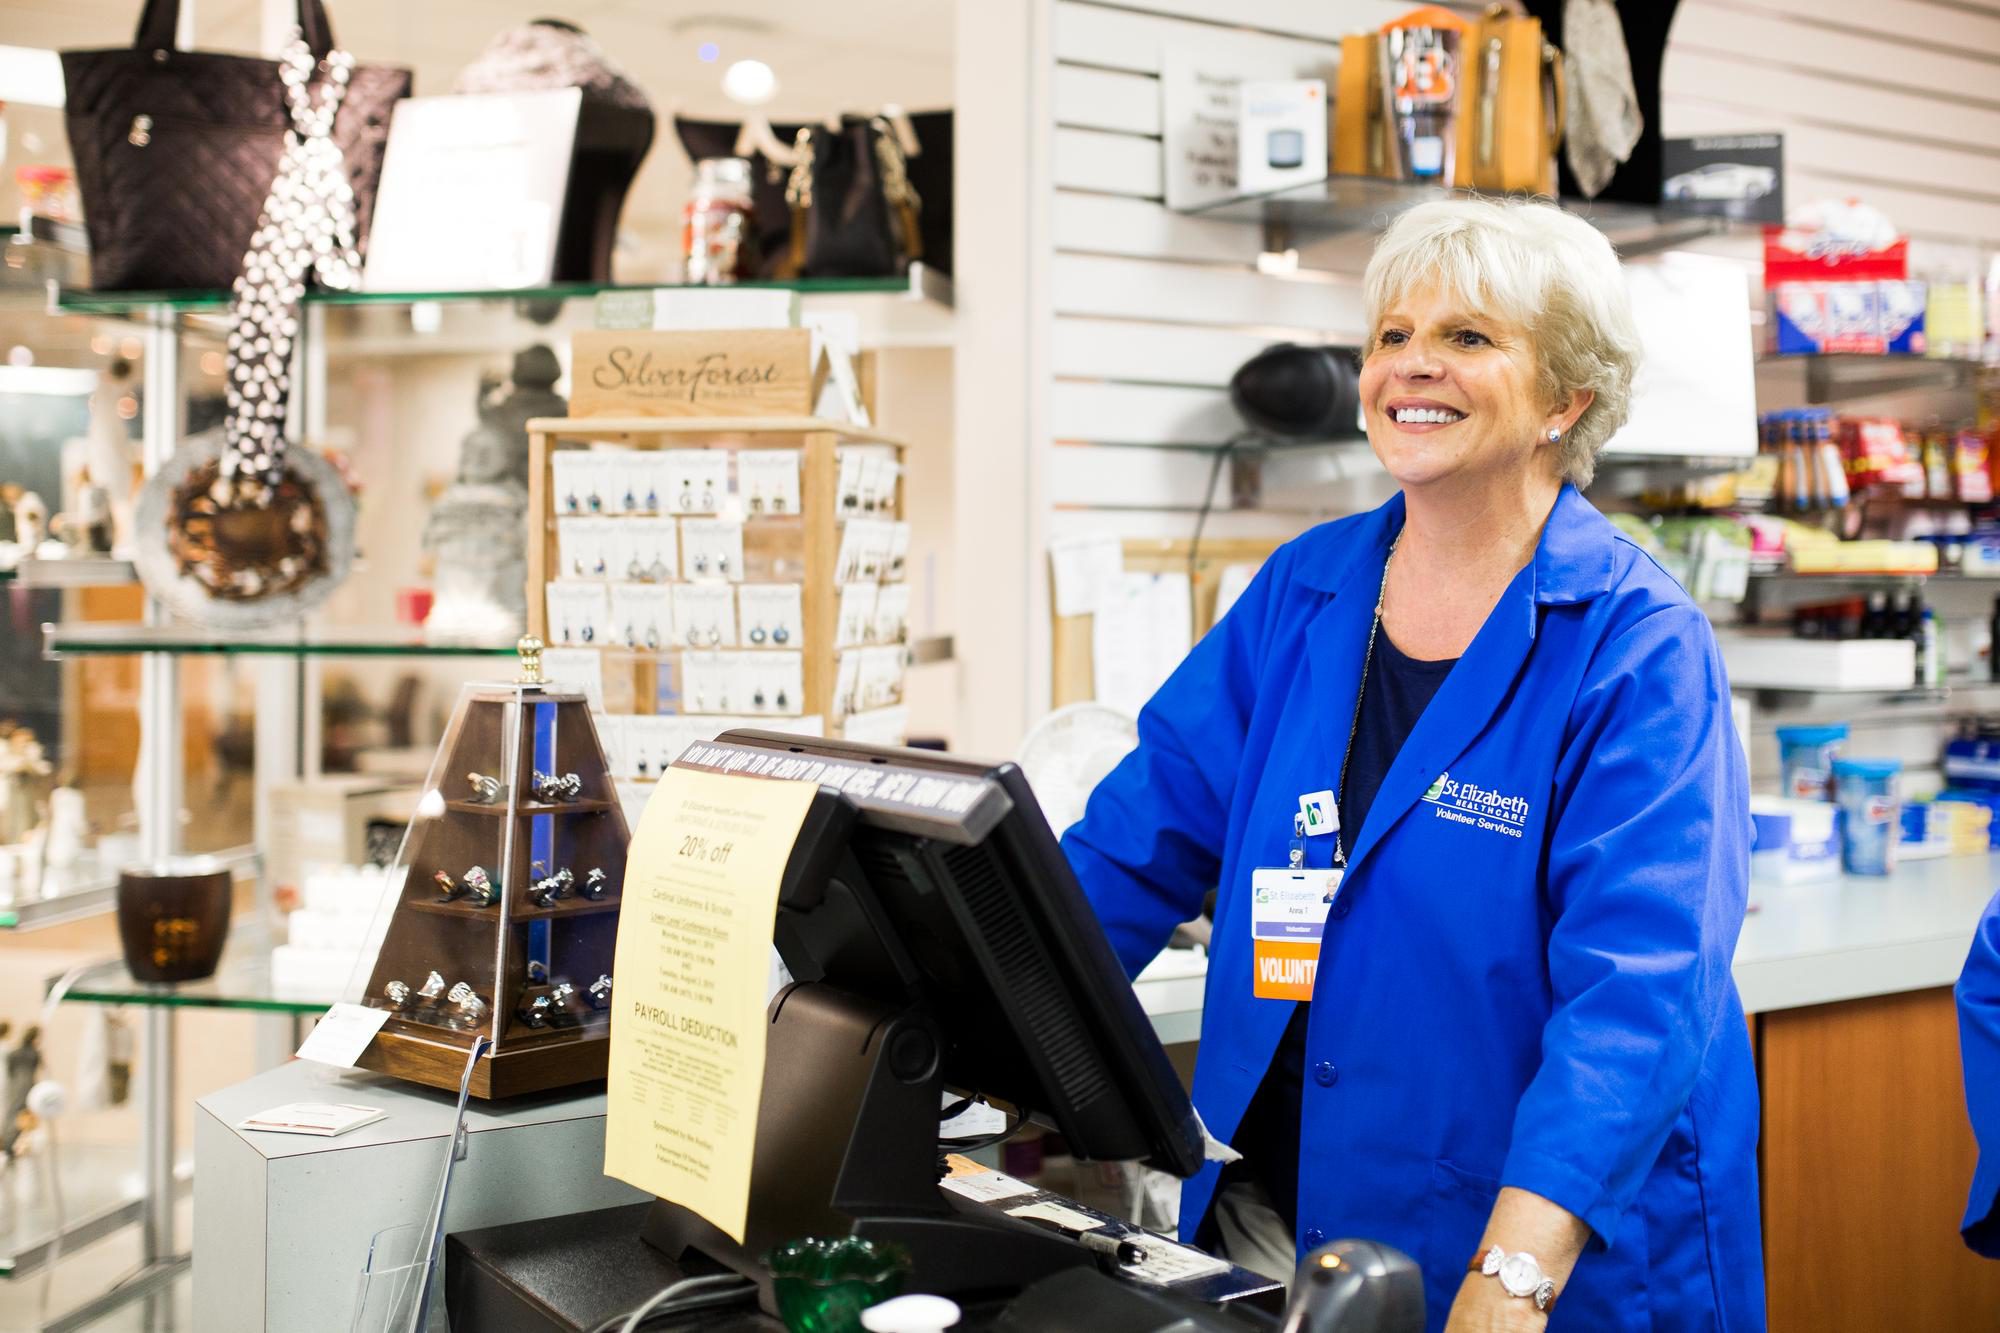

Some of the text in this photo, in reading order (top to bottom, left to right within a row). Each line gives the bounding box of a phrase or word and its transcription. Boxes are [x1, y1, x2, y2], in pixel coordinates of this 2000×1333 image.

[698, 748, 731, 769] DON'T
[724, 751, 756, 773] HAVE
[772, 758, 815, 781] CRAZY
[816, 765, 858, 791] WORK
[1456, 800, 1526, 824] HEALTHCARE
[1460, 784, 1529, 816] Elizabeth
[1436, 807, 1522, 838] Volunteer Services
[678, 835, 734, 864] 20% off
[1280, 890, 1316, 901] Elizabeth
[635, 1002, 678, 1030] PAYROLL
[680, 1016, 738, 1048] DEDUCTION
